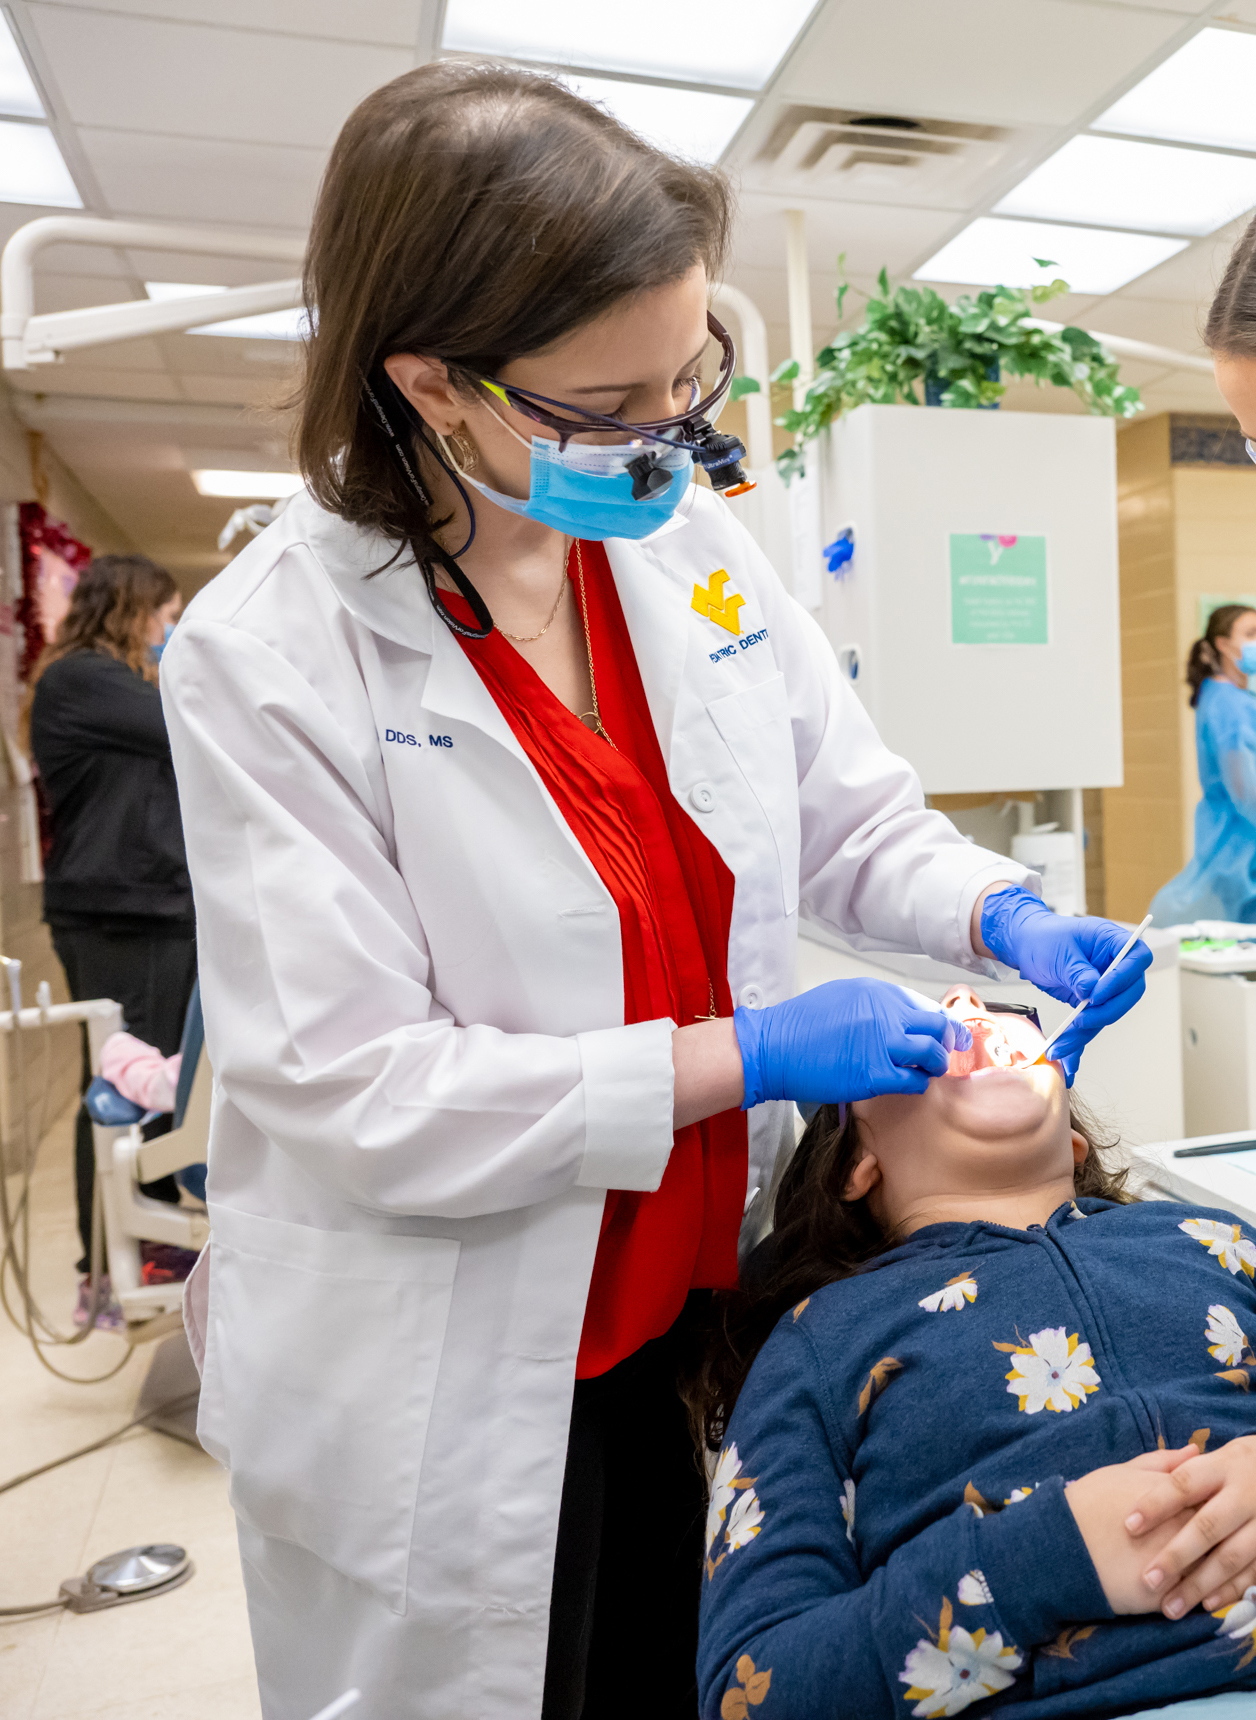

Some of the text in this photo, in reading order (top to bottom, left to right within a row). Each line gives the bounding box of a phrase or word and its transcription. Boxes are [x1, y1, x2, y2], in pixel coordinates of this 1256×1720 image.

[708, 644, 738, 664] PATRIC
[385, 728, 454, 748] DDS, MS
